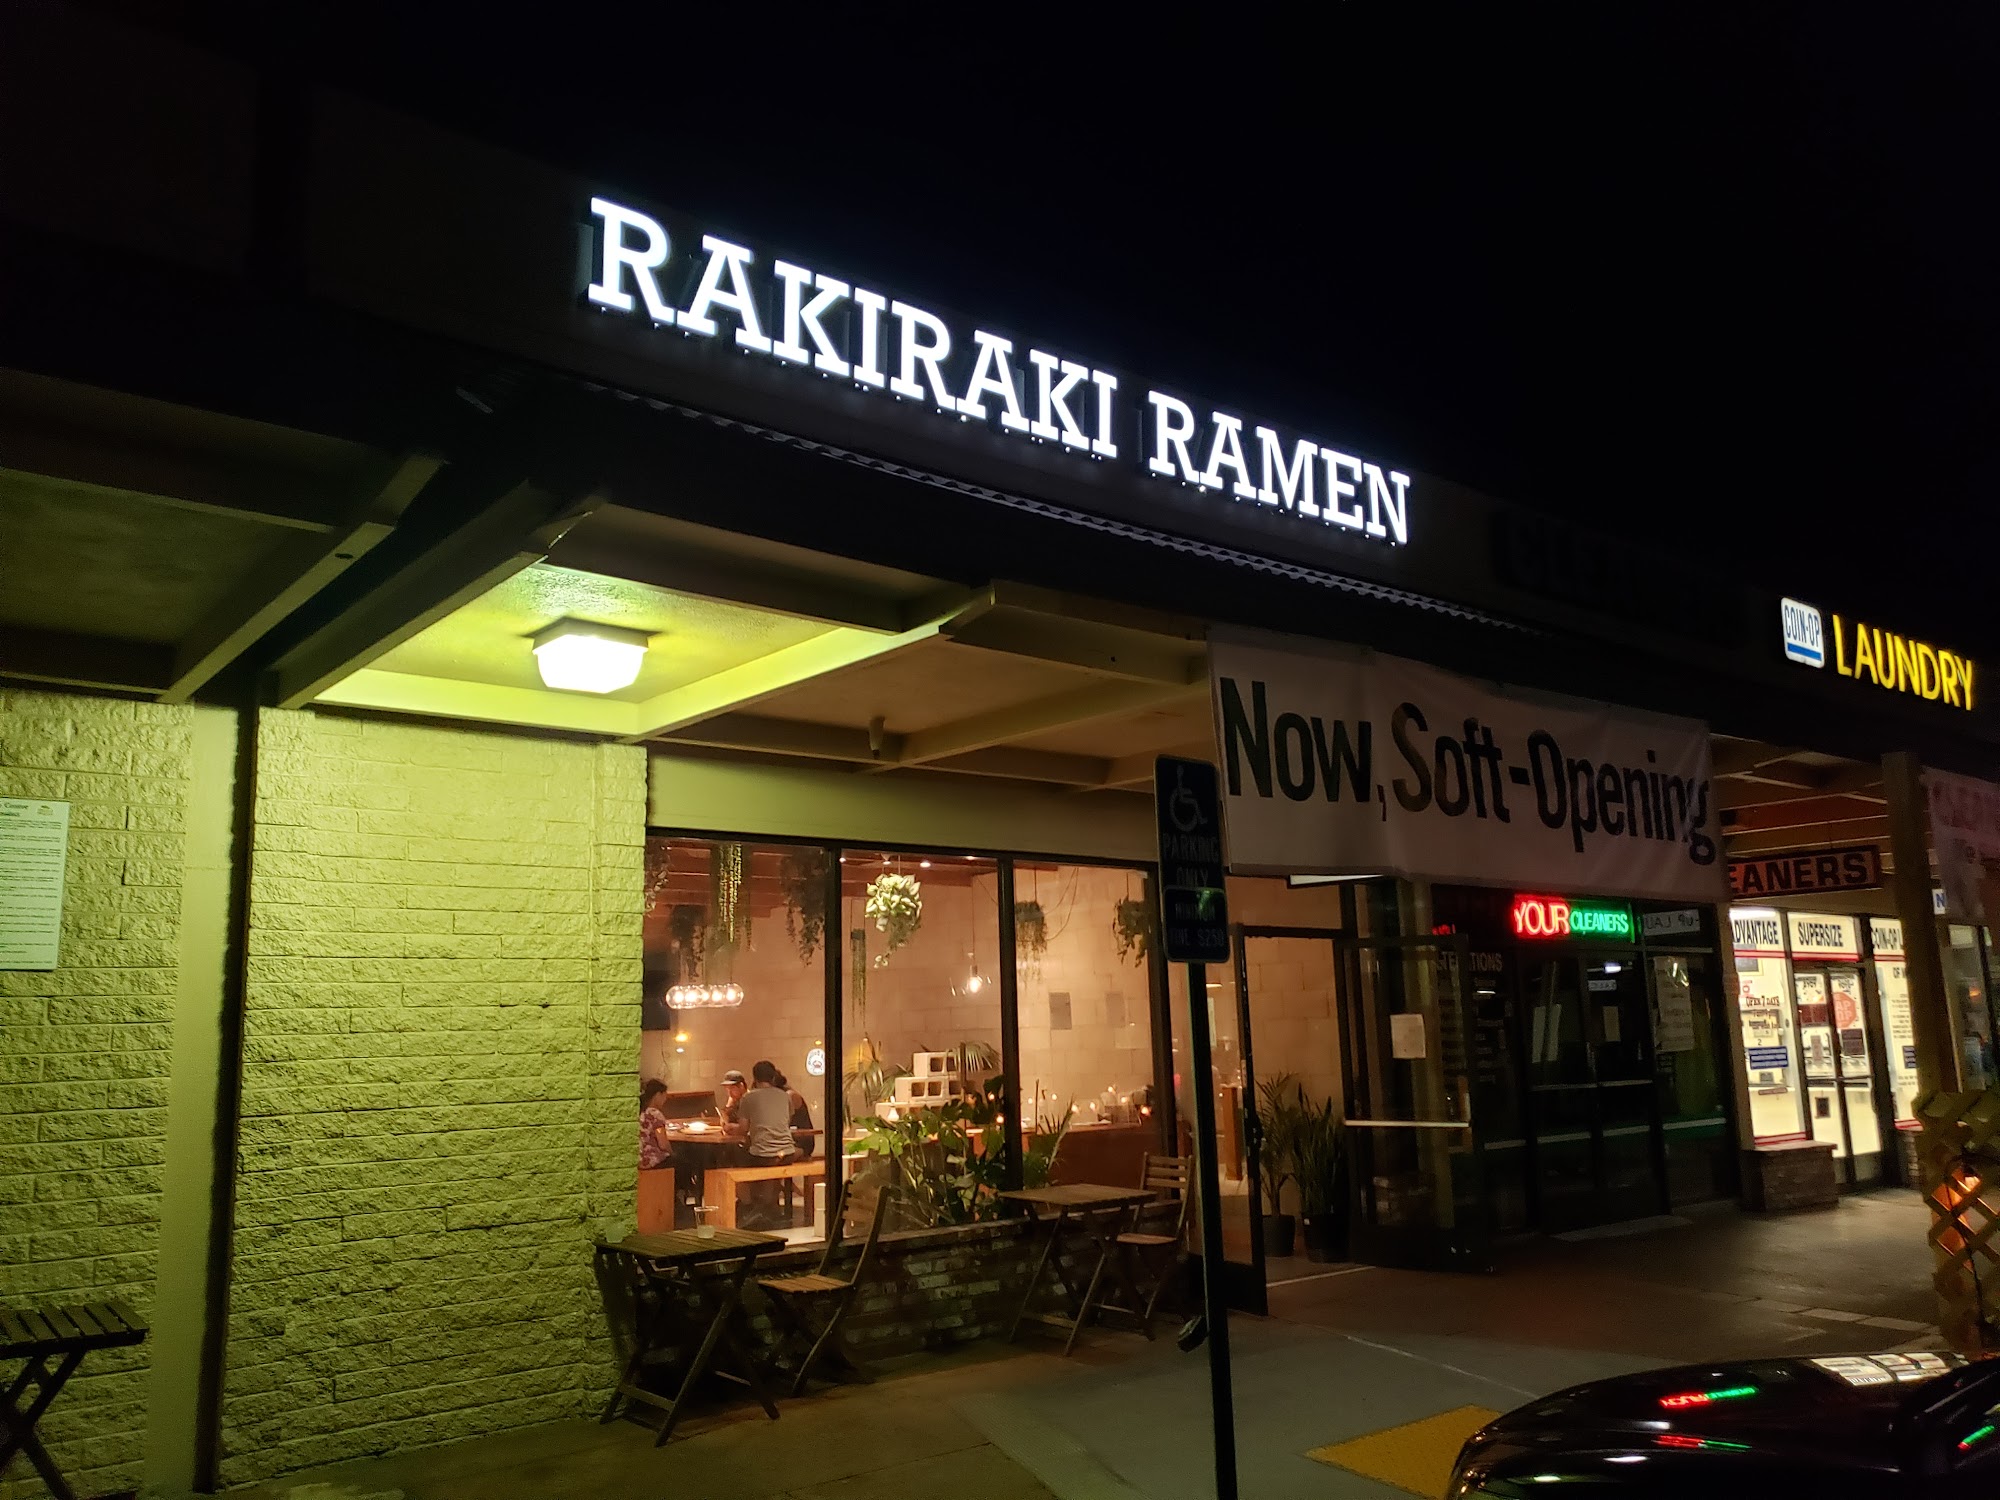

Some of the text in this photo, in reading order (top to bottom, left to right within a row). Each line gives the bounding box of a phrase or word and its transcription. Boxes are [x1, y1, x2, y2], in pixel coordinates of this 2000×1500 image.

[588, 197, 1412, 545] RAKIRAKI RAMEN
[1785, 604, 1820, 648] COIN-OP
[1832, 614, 1972, 711] LAUNDRY
[1220, 677, 1716, 865] Now, Soft-Opening
[1162, 831, 1219, 864] PARKING
[1513, 901, 1629, 936] YOUR CLEANERS
[1798, 922, 1843, 947] SUPERSIZE
